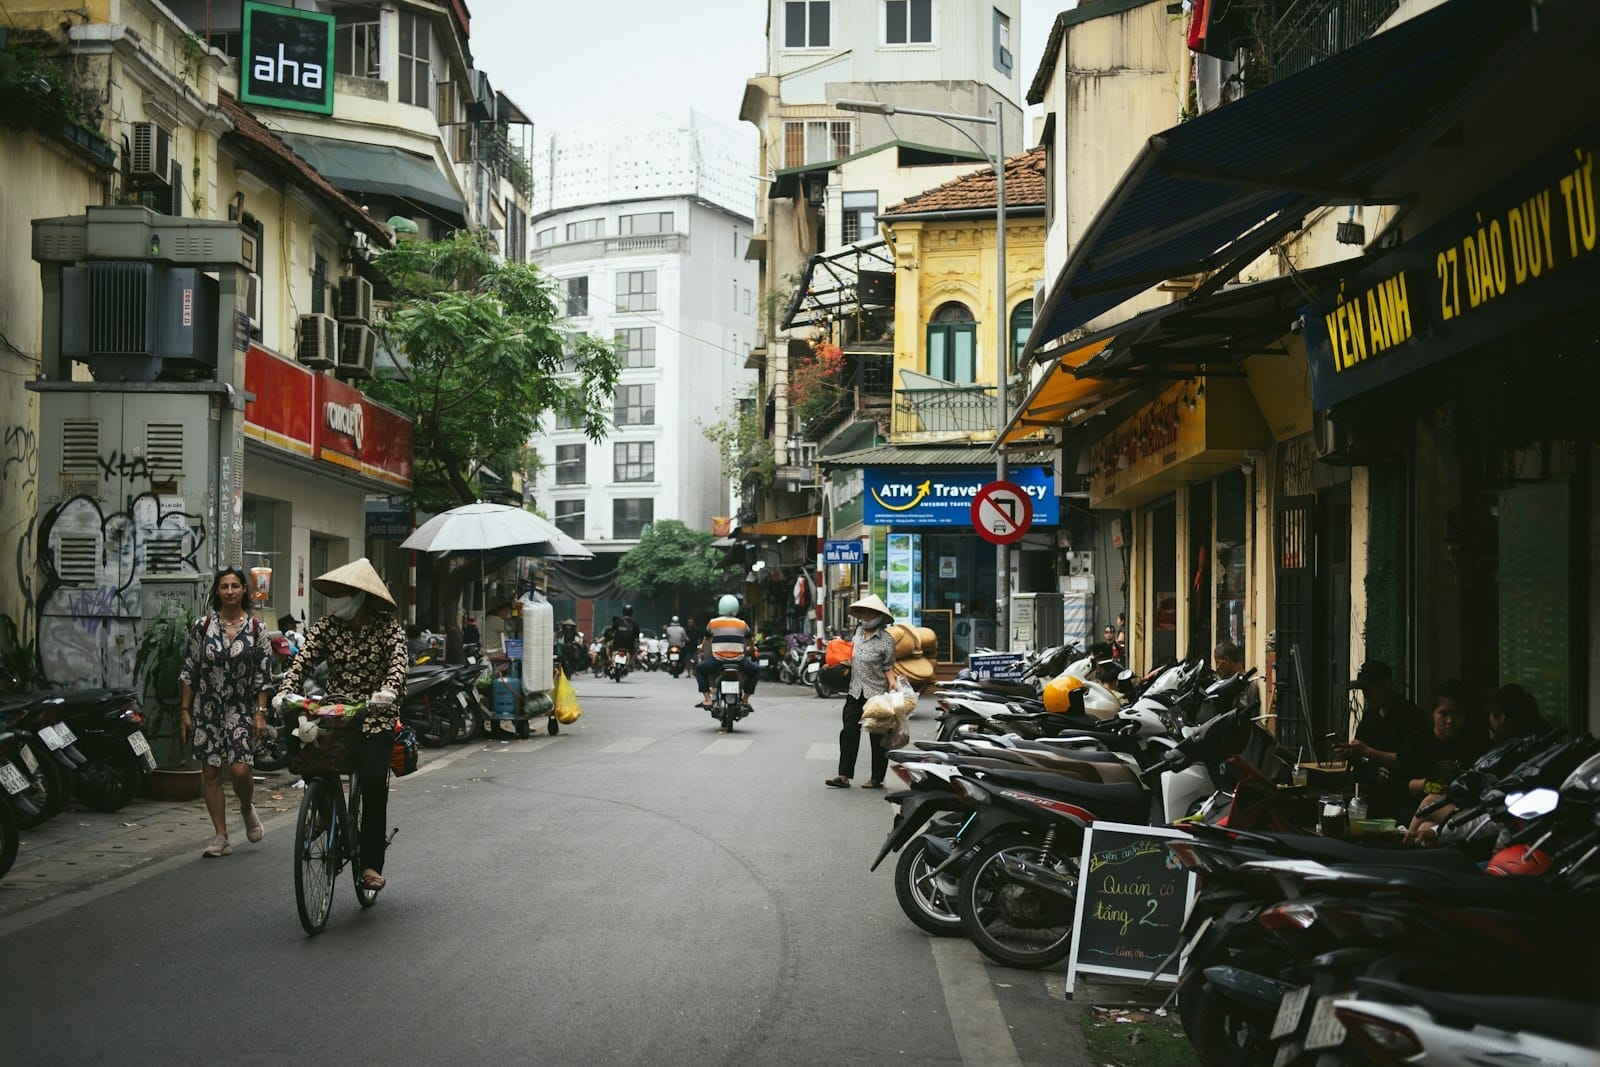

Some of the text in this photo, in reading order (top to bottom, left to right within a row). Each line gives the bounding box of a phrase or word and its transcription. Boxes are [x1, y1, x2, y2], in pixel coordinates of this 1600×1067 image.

[254, 43, 322, 89] aha
[1325, 147, 1597, 373] YẾN ANH 27 ĐÀO DUY TỪ
[880, 483, 913, 498] ATM
[1102, 874, 1151, 895] Quán
[1139, 899, 1159, 927] 2
